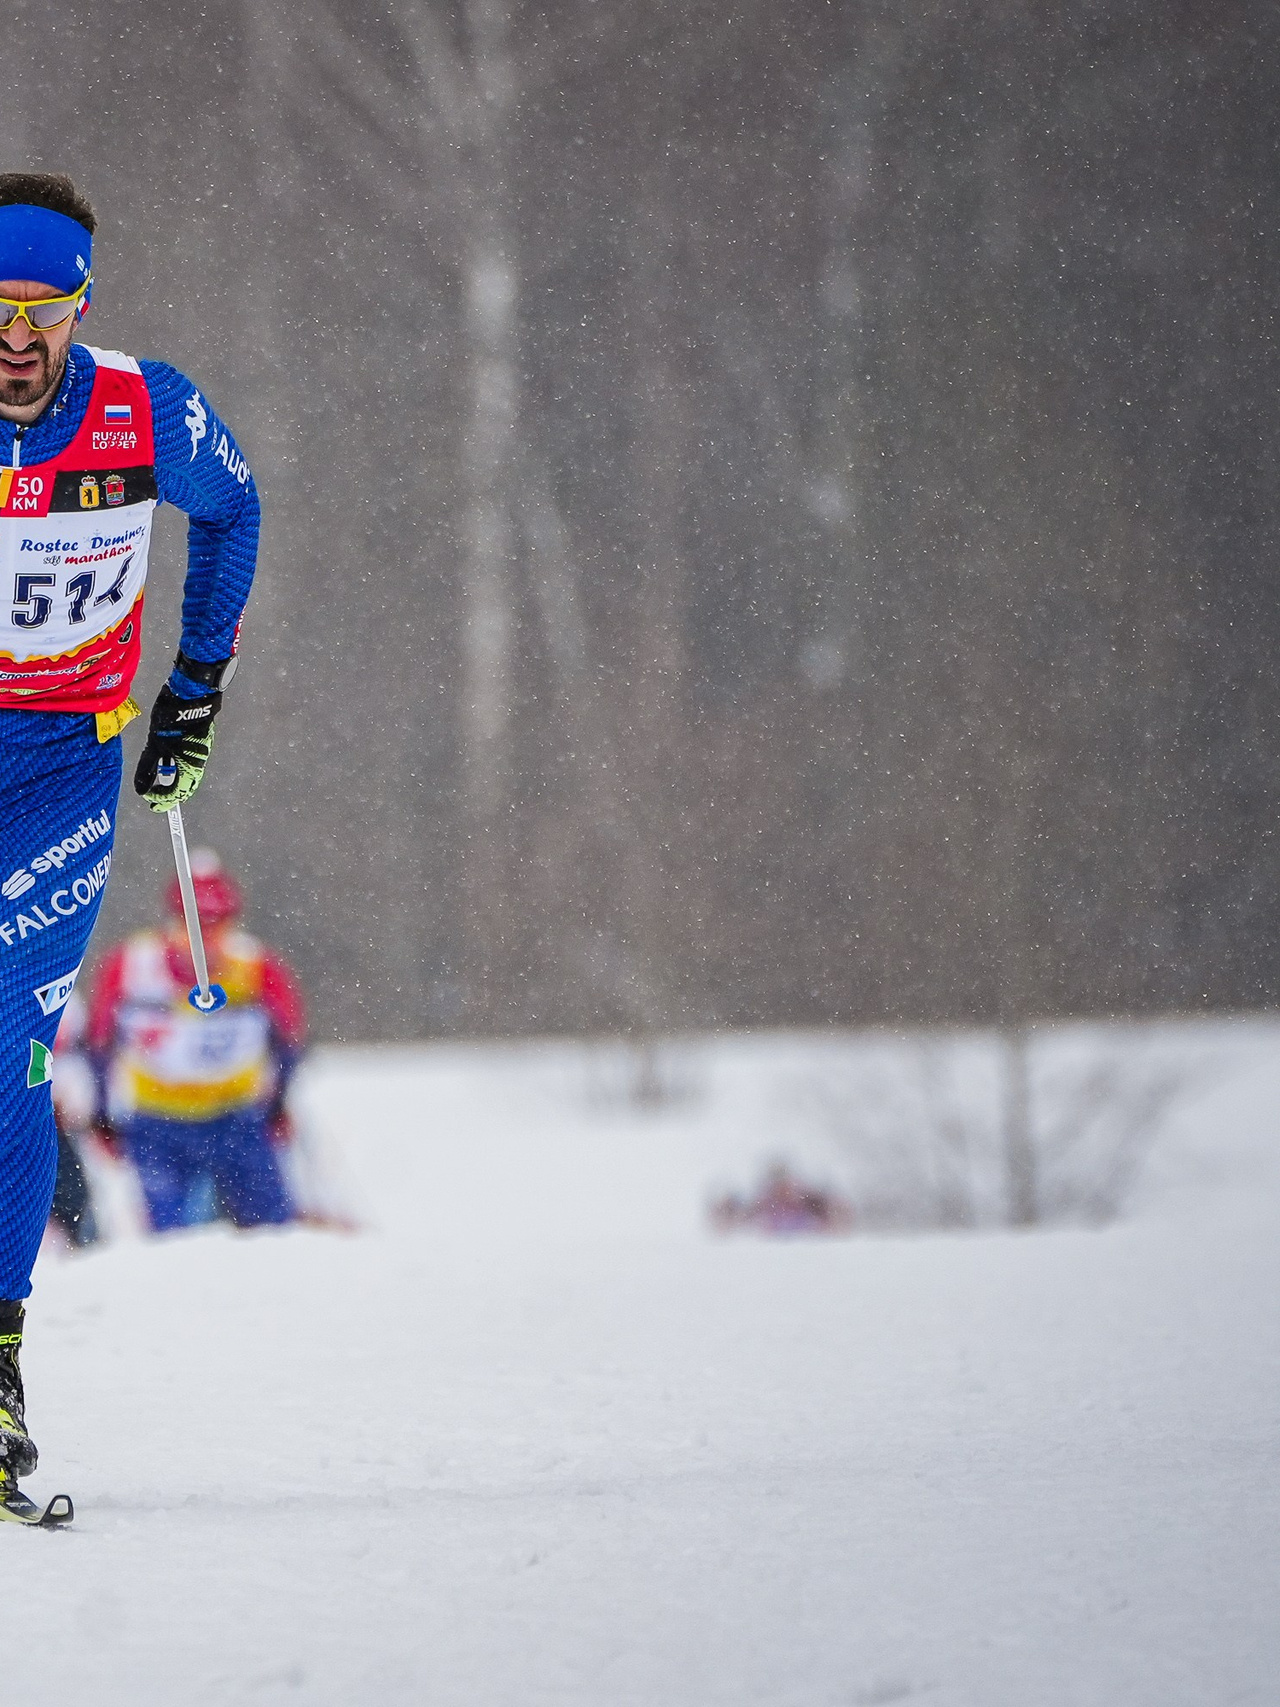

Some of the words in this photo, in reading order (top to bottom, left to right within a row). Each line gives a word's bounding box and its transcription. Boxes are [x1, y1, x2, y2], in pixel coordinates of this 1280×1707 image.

[92, 431, 138, 441] RUSSIA
[16, 477, 44, 496] 50
[12, 497, 38, 511] KM
[20, 538, 79, 553] Rostec
[64, 544, 133, 565] marathon
[30, 808, 112, 875] sportful
